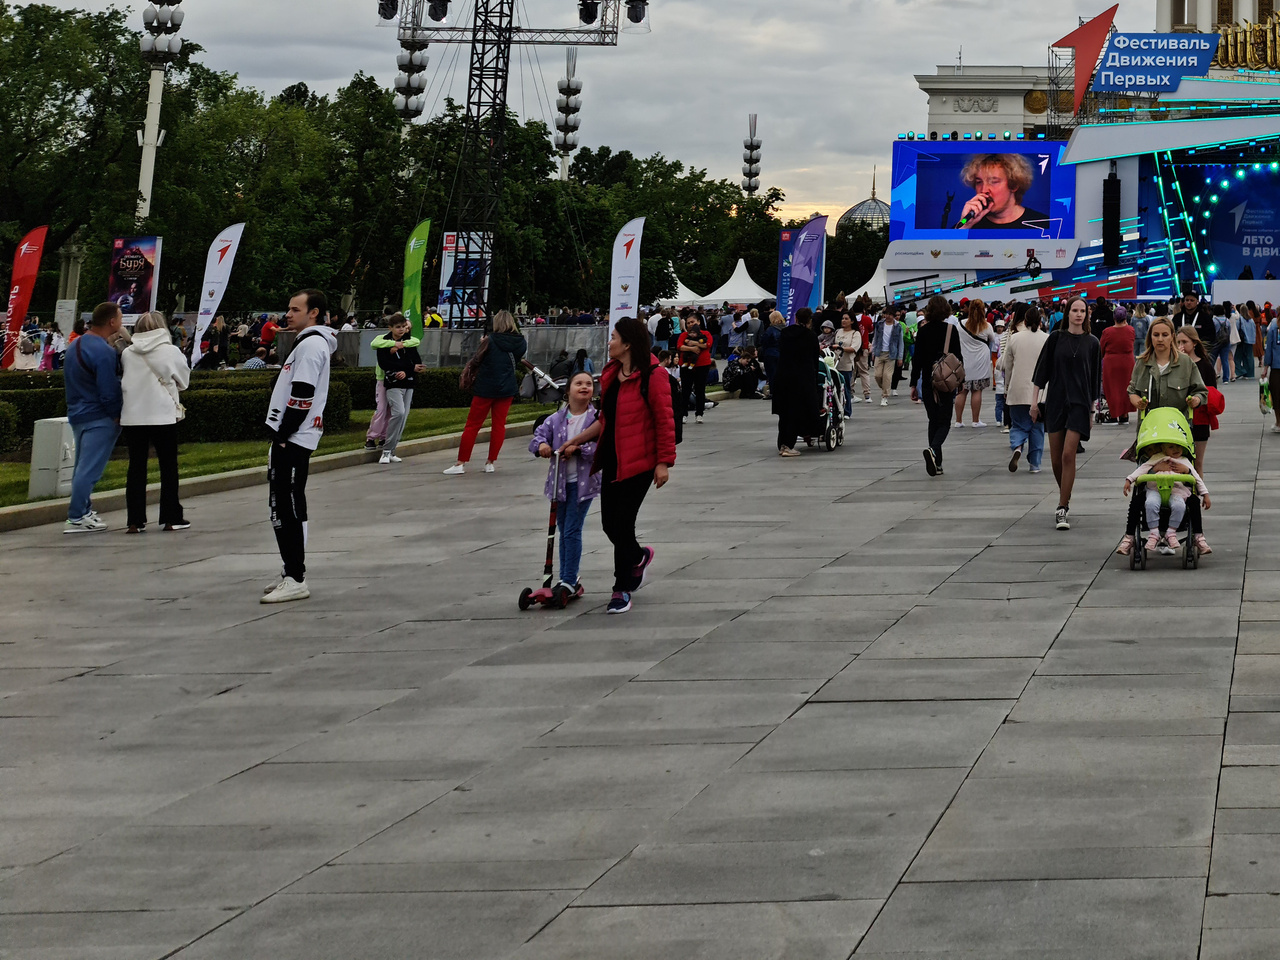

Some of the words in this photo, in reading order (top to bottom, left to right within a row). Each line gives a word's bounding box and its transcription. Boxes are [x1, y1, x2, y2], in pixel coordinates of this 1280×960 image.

[1114, 35, 1210, 50] Фестиваль
[1106, 52, 1198, 67] Движения
[1101, 71, 1170, 88] Первых
[1242, 235, 1274, 245] ЛЕТО
[1243, 247, 1250, 256] В
